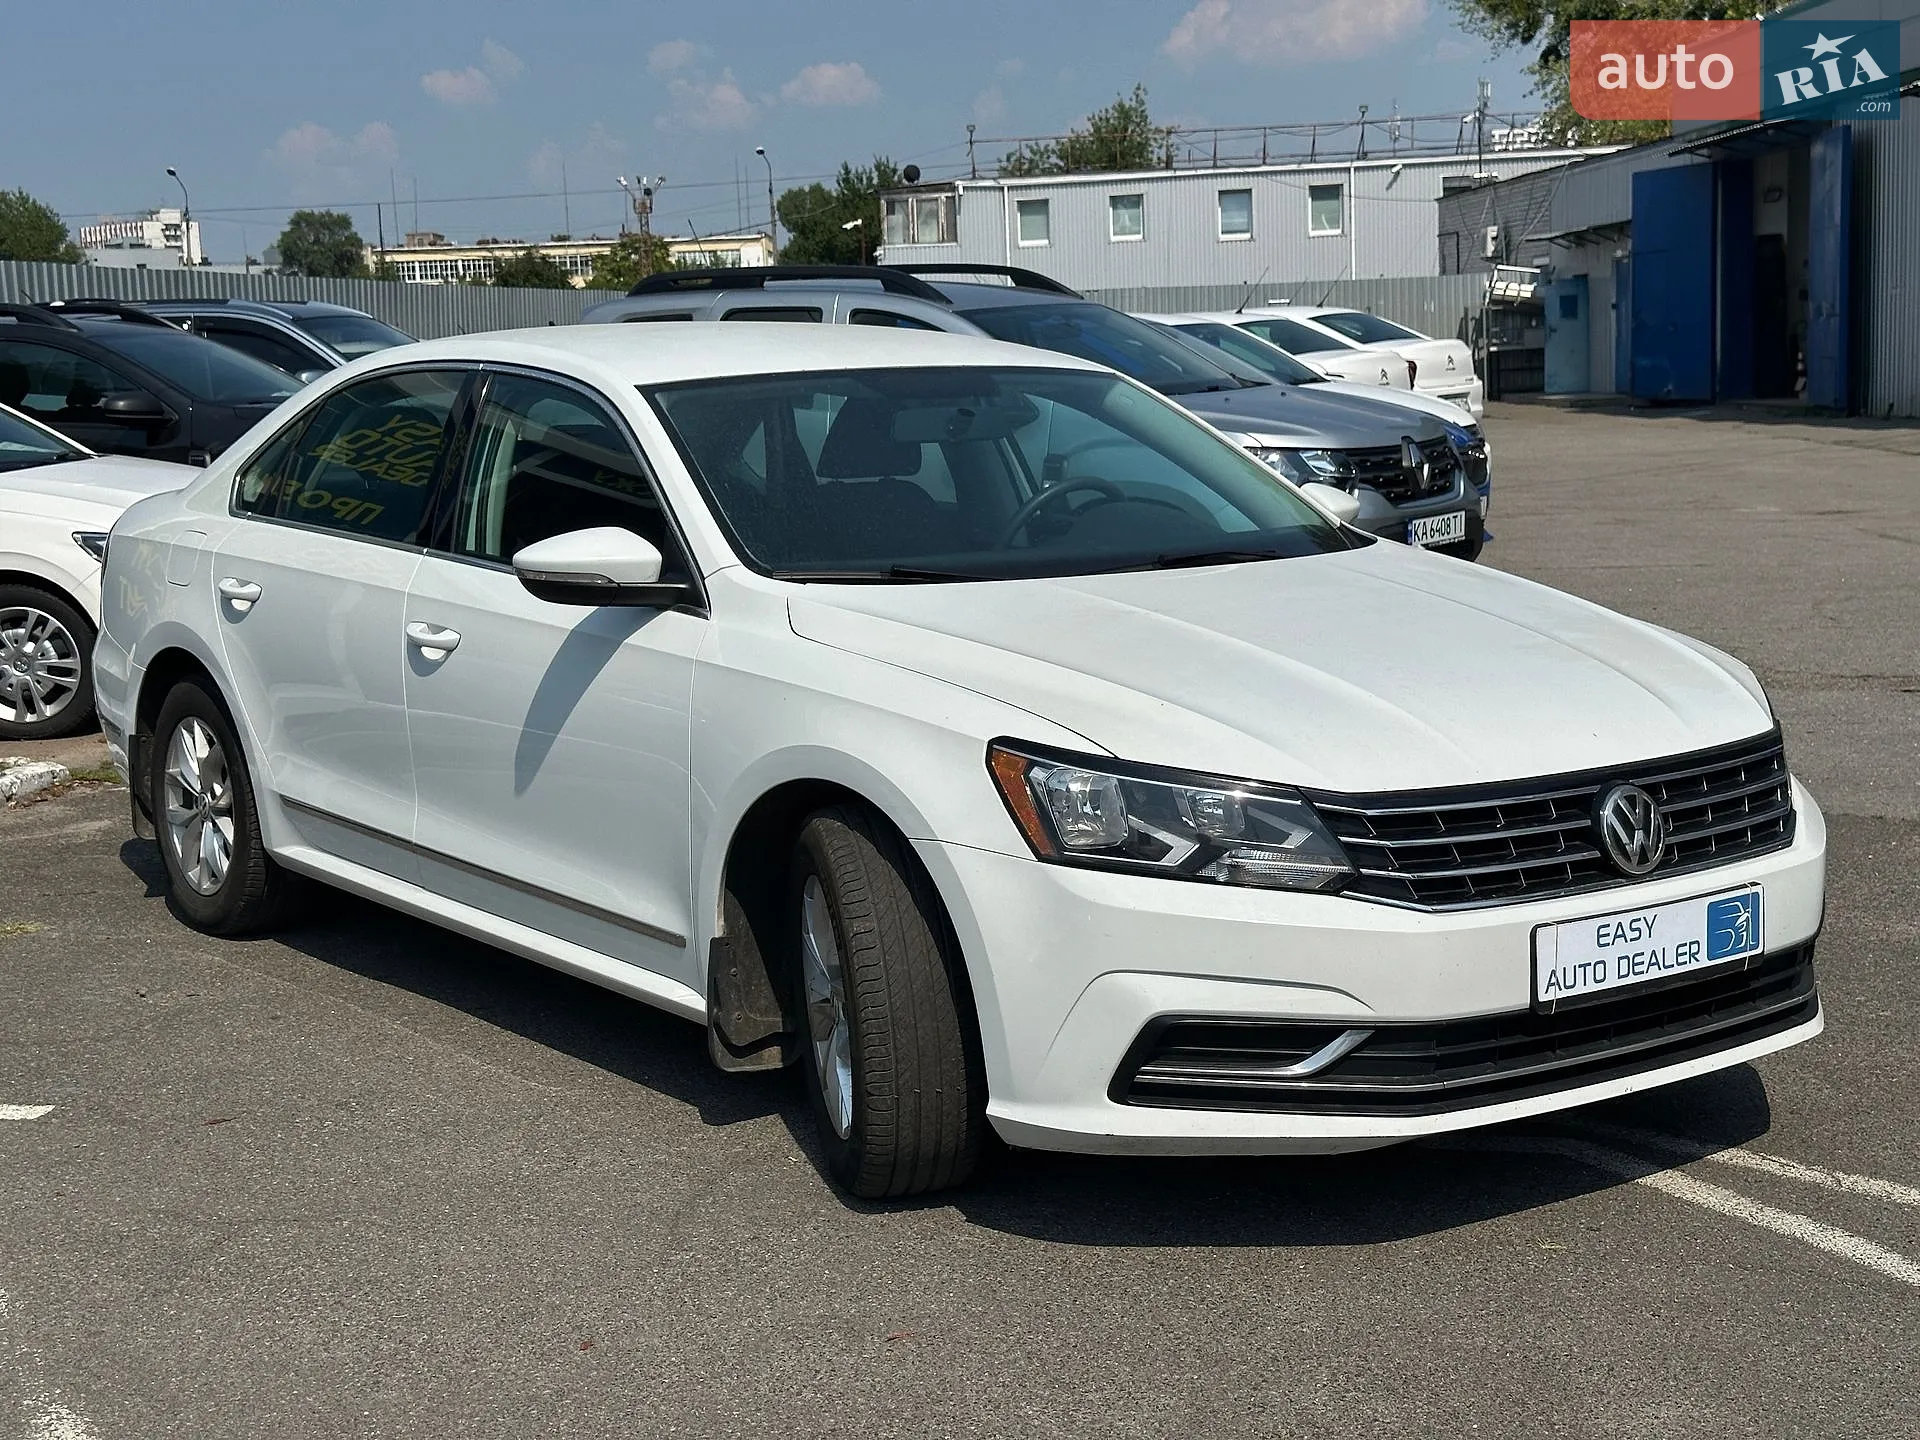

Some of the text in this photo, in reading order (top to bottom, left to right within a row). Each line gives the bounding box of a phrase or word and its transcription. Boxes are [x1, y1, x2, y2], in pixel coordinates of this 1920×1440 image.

[1596, 914, 1659, 948] EASY
[1544, 939, 1701, 994] AUTO DEALER
